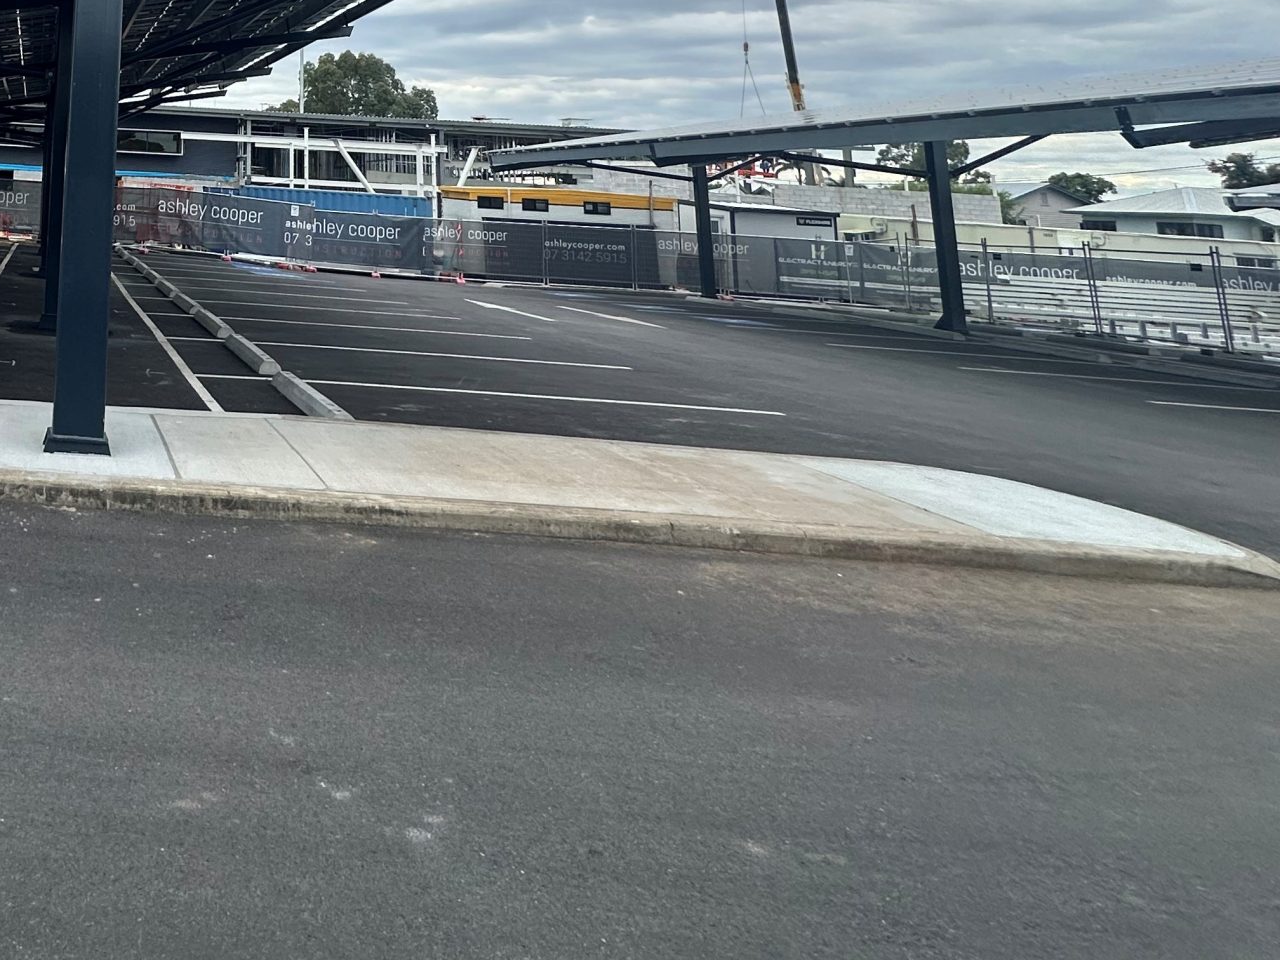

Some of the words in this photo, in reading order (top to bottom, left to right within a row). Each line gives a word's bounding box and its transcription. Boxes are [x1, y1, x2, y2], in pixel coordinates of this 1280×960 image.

[158, 198, 207, 221] ashley
[211, 204, 264, 225] cooper
[113, 214, 136, 227] 915
[283, 231, 300, 244] 07
[305, 234, 313, 246] 3
[348, 223, 401, 242] cooper
[424, 224, 463, 241] ashley
[467, 228, 508, 244] cooper
[544, 239, 626, 252] ashleycooper.com
[657, 238, 698, 255] ashley
[712, 241, 750, 256] ooper
[543, 248, 557, 260] 07
[561, 250, 592, 263] 3142
[596, 251, 628, 264] 5915
